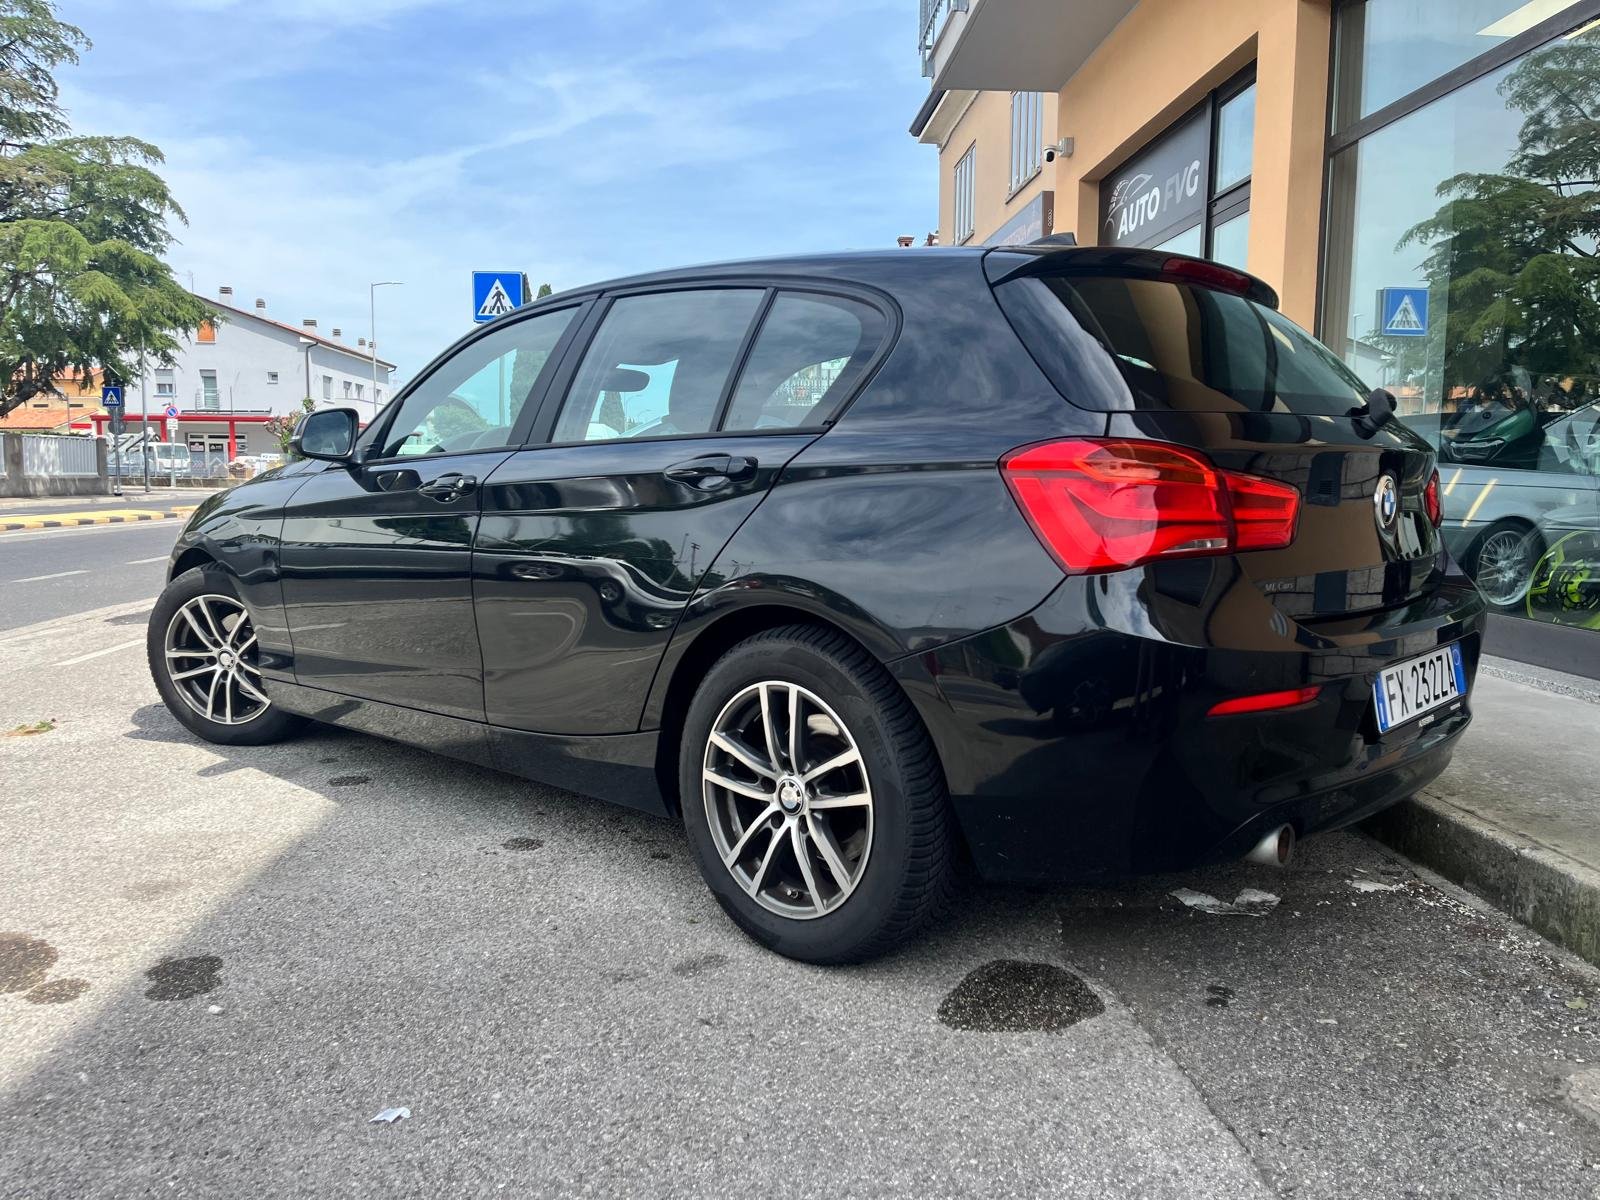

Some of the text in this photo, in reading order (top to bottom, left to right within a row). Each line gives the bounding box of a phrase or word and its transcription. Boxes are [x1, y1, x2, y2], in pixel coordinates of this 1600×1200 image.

[1117, 160, 1201, 240] AUTO FVG
[1385, 669, 1409, 722] FX
[1411, 652, 1457, 710] 232ZA
